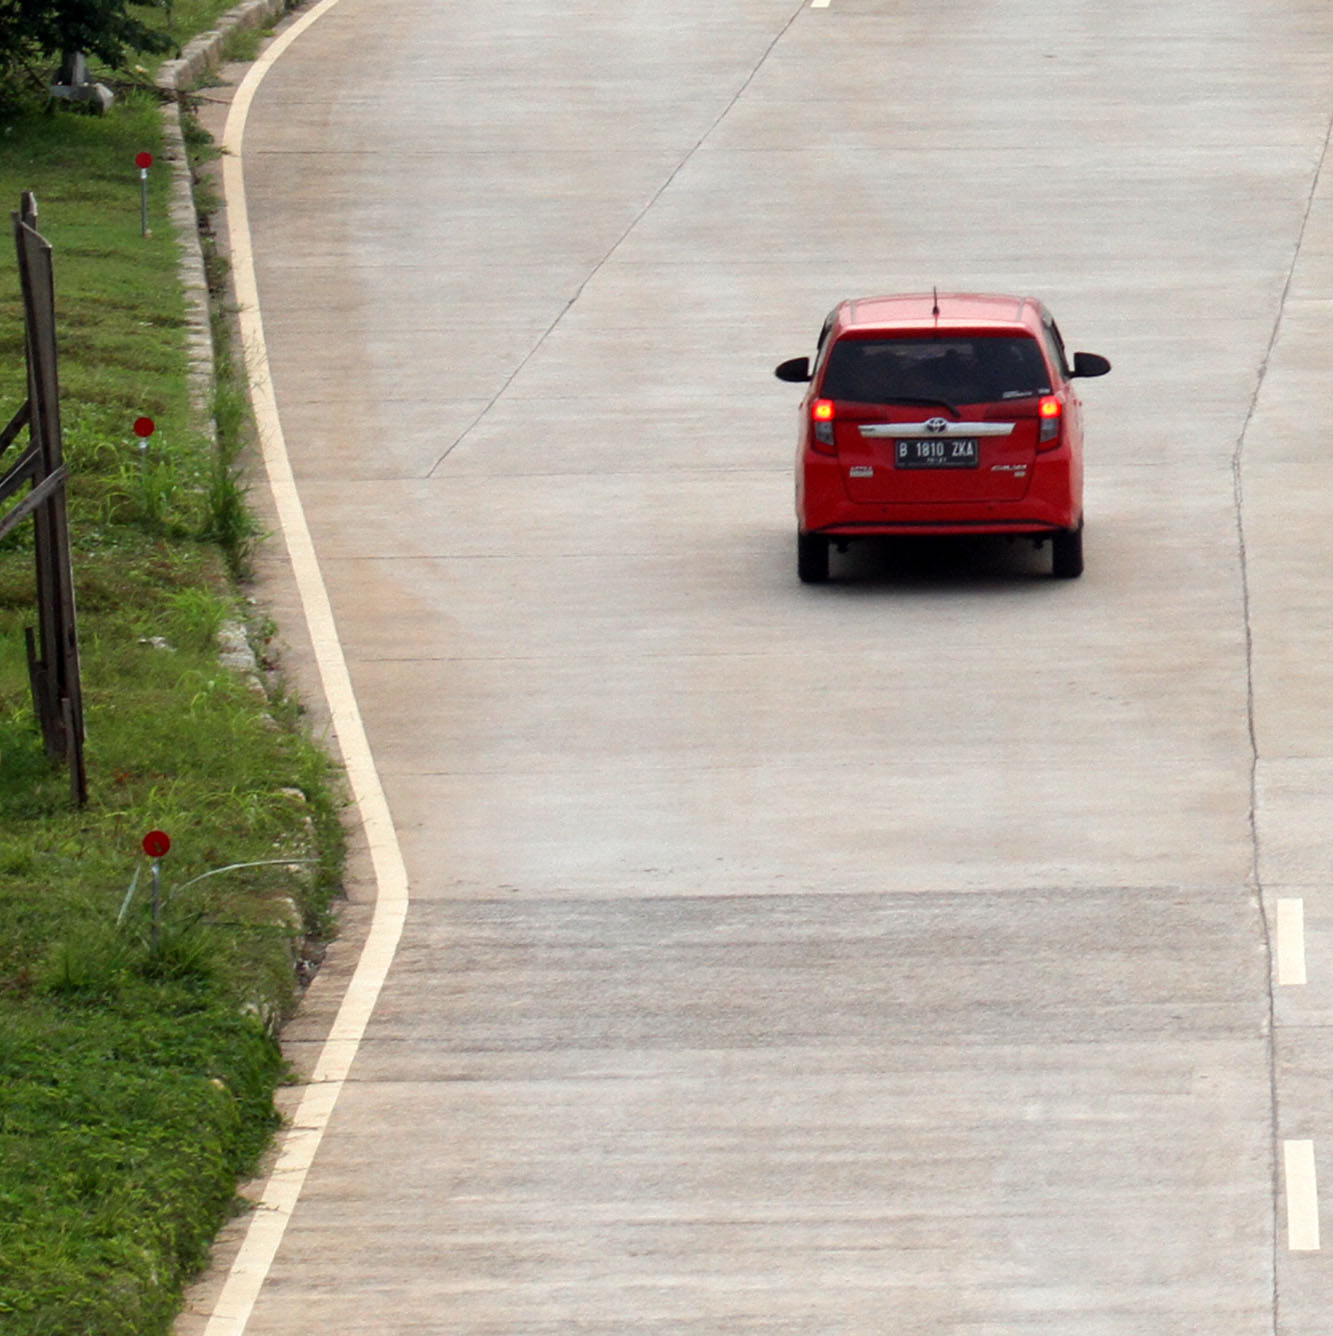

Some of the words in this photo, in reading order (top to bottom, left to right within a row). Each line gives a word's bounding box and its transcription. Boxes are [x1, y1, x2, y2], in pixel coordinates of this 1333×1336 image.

[899, 442, 908, 457] B
[916, 442, 945, 457] 1810
[951, 441, 974, 457] ZKA
